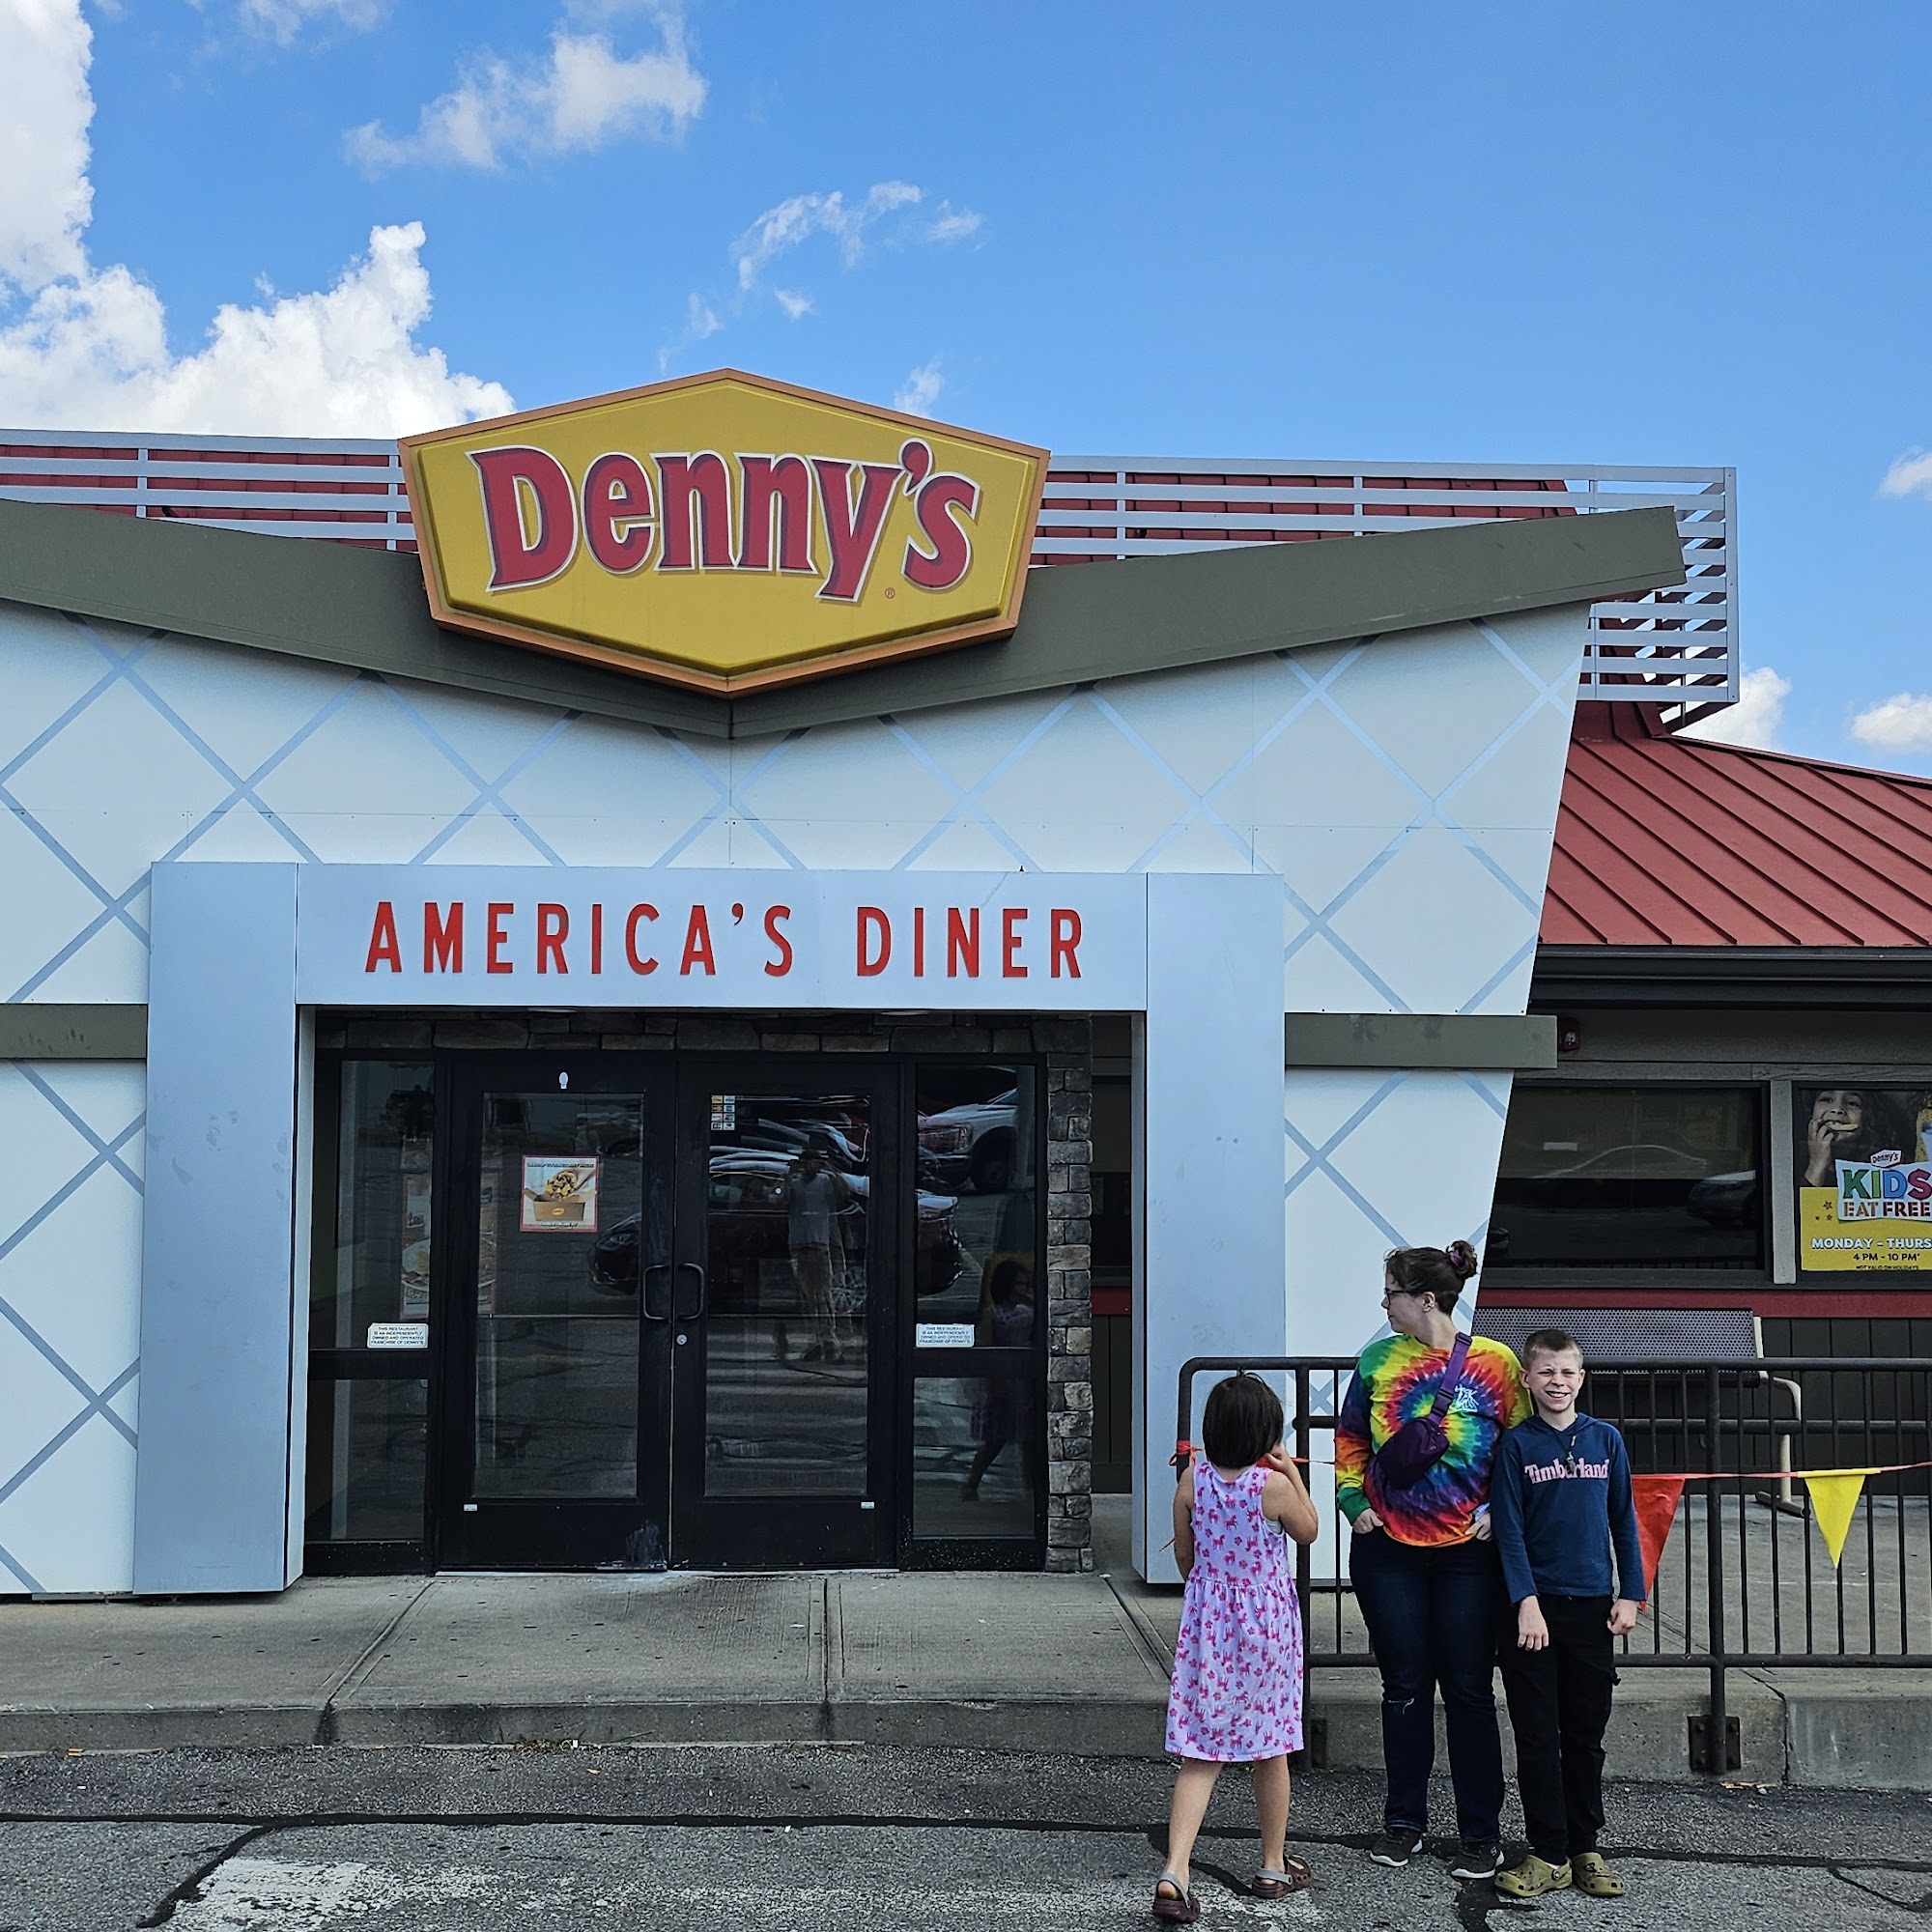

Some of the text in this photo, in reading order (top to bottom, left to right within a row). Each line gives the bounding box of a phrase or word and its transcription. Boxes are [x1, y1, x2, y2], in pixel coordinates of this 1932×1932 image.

[465, 438, 981, 603] Denny's
[365, 901, 1082, 979] AMERICA'S DINER
[1872, 1152, 1899, 1163] Denny's
[1842, 1169, 1932, 1201] KIDS
[1843, 1202, 1931, 1217] EAT FREE
[1811, 1237, 1874, 1250] MONDAY
[1886, 1237, 1932, 1250] THURS
